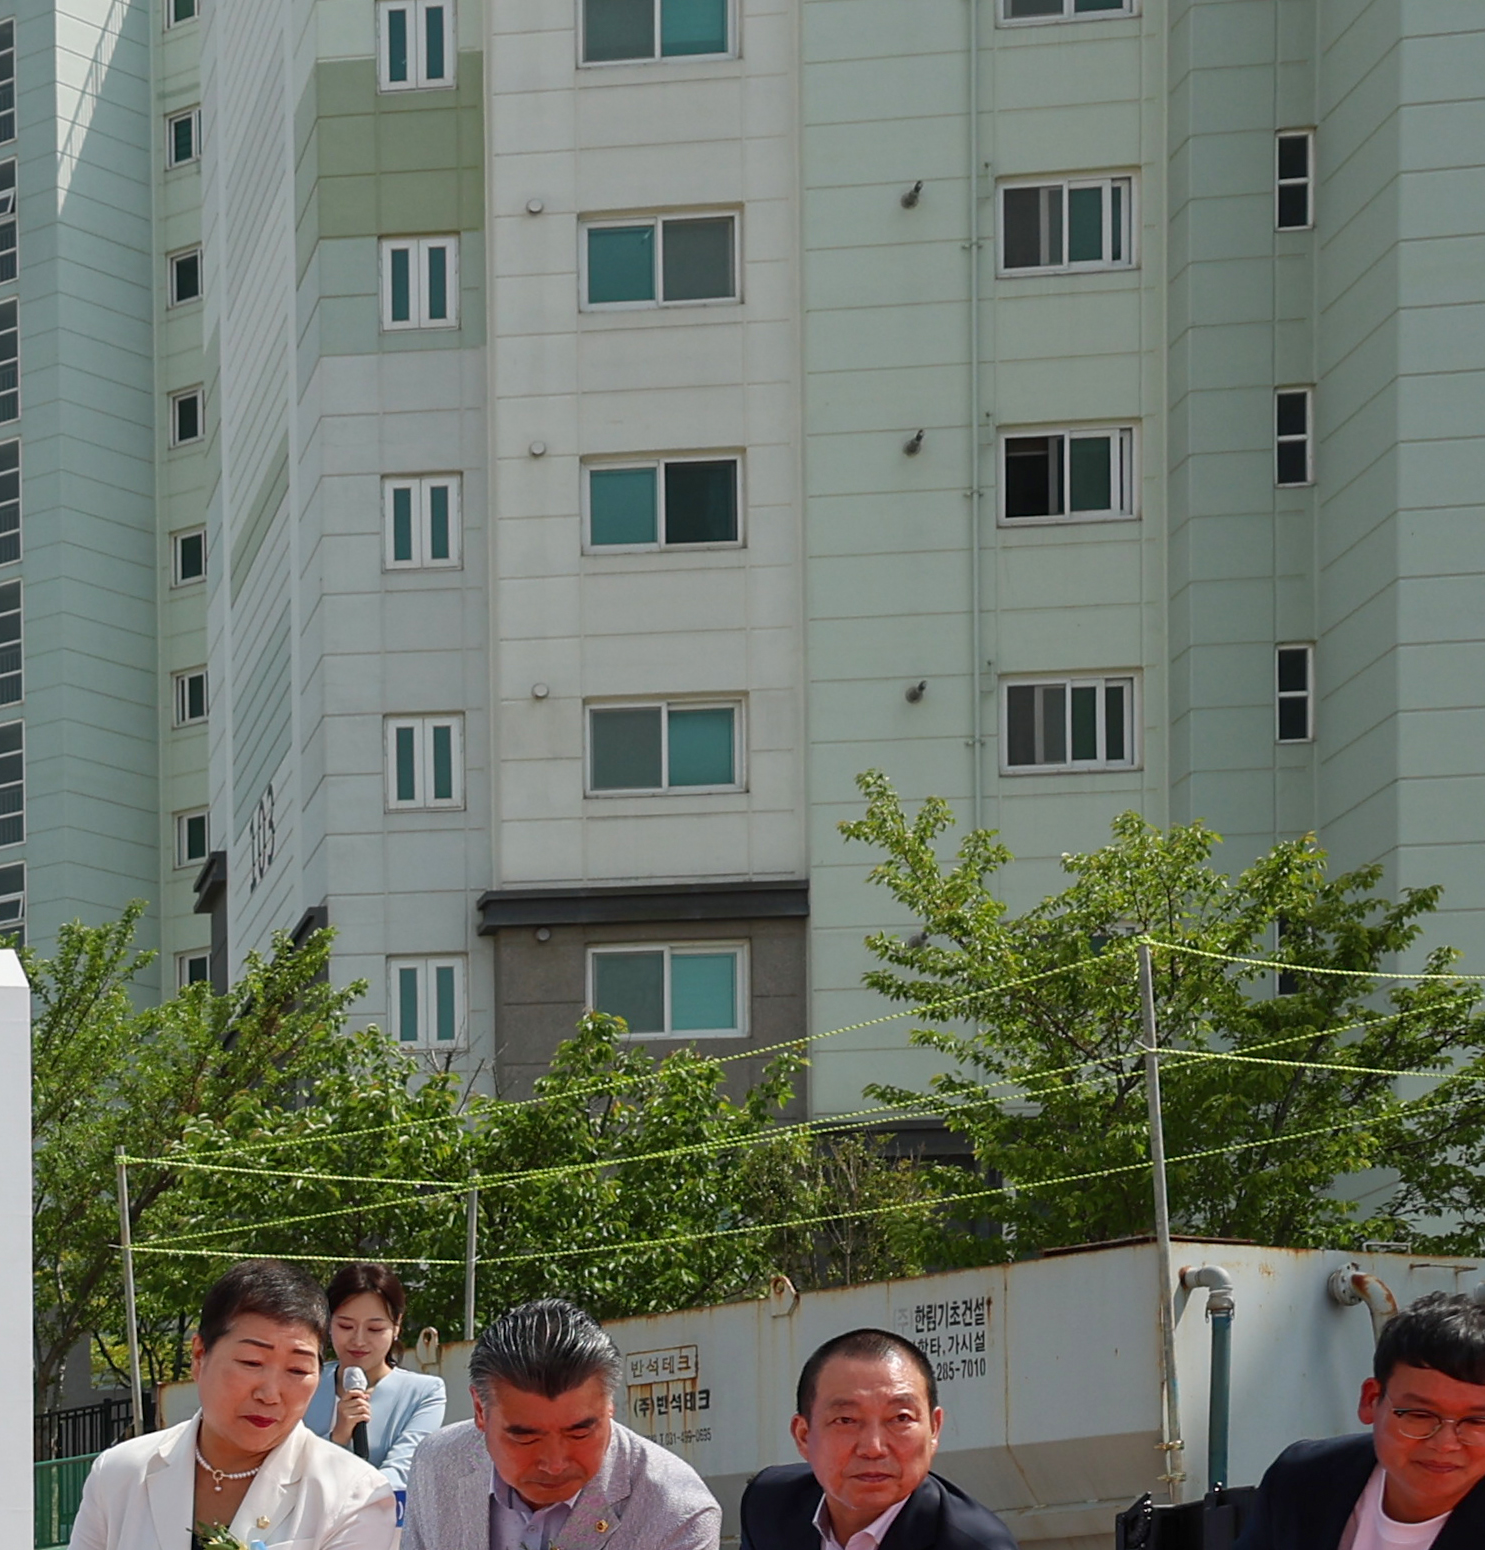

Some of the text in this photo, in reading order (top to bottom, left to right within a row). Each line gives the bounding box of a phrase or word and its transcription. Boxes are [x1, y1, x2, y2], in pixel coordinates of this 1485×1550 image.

[249, 782, 276, 894] 103
[631, 1355, 692, 1379] 반석테크
[633, 1388, 711, 1418] (주)반석테크
